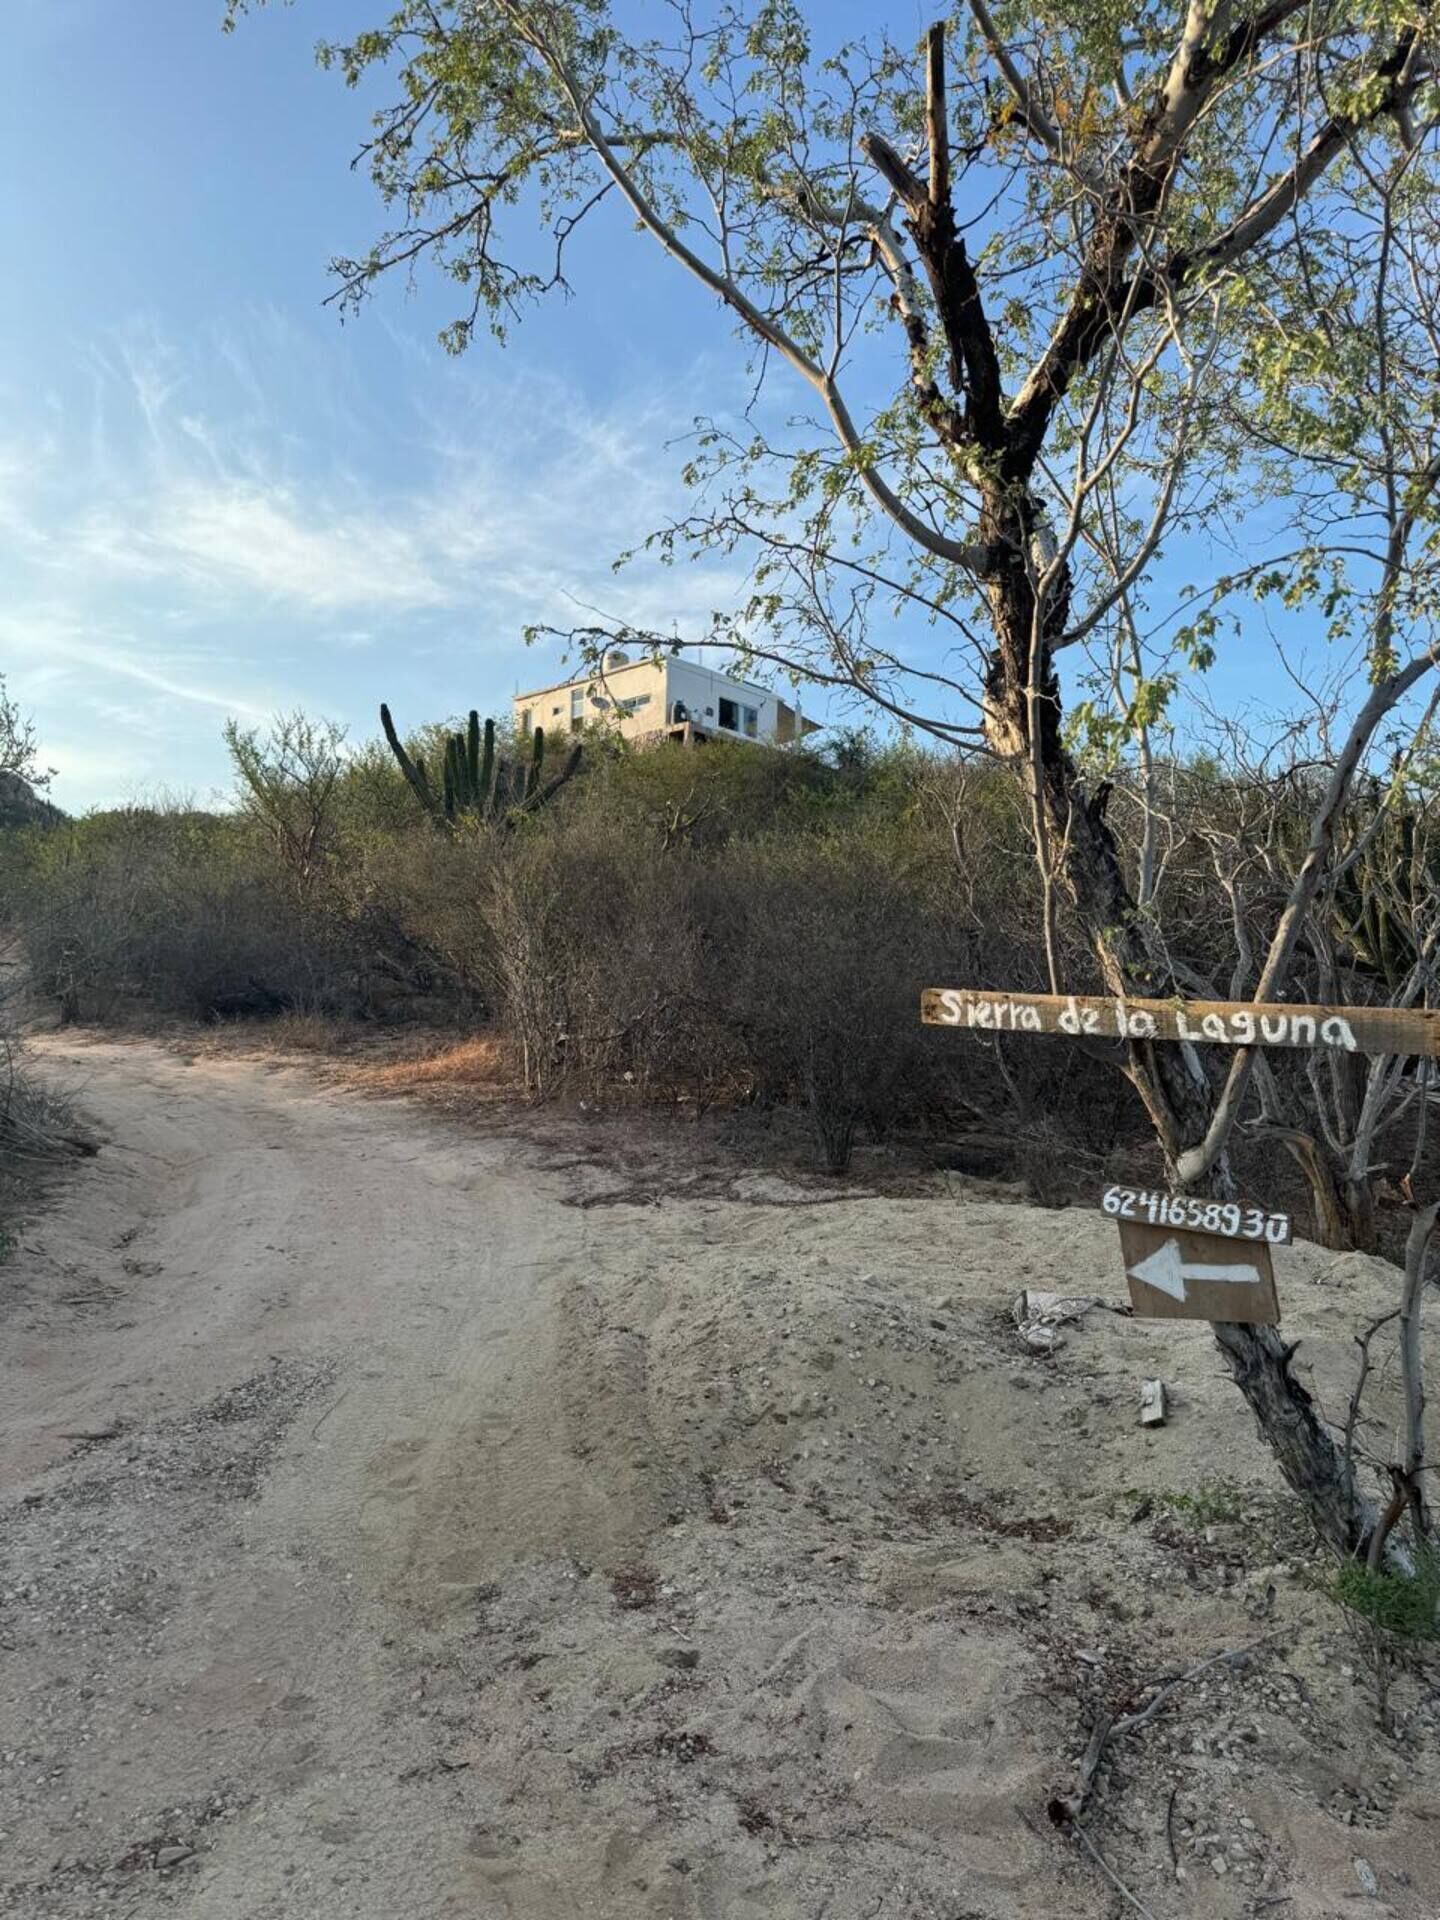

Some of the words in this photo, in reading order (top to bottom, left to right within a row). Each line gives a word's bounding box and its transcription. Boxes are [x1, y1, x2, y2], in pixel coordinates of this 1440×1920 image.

[940, 990, 1041, 1032] Sierra
[1059, 996, 1100, 1035] de
[1116, 998, 1156, 1037] la
[1176, 1011, 1357, 1051] Laguna
[1103, 1186, 1289, 1243] 6241658930
